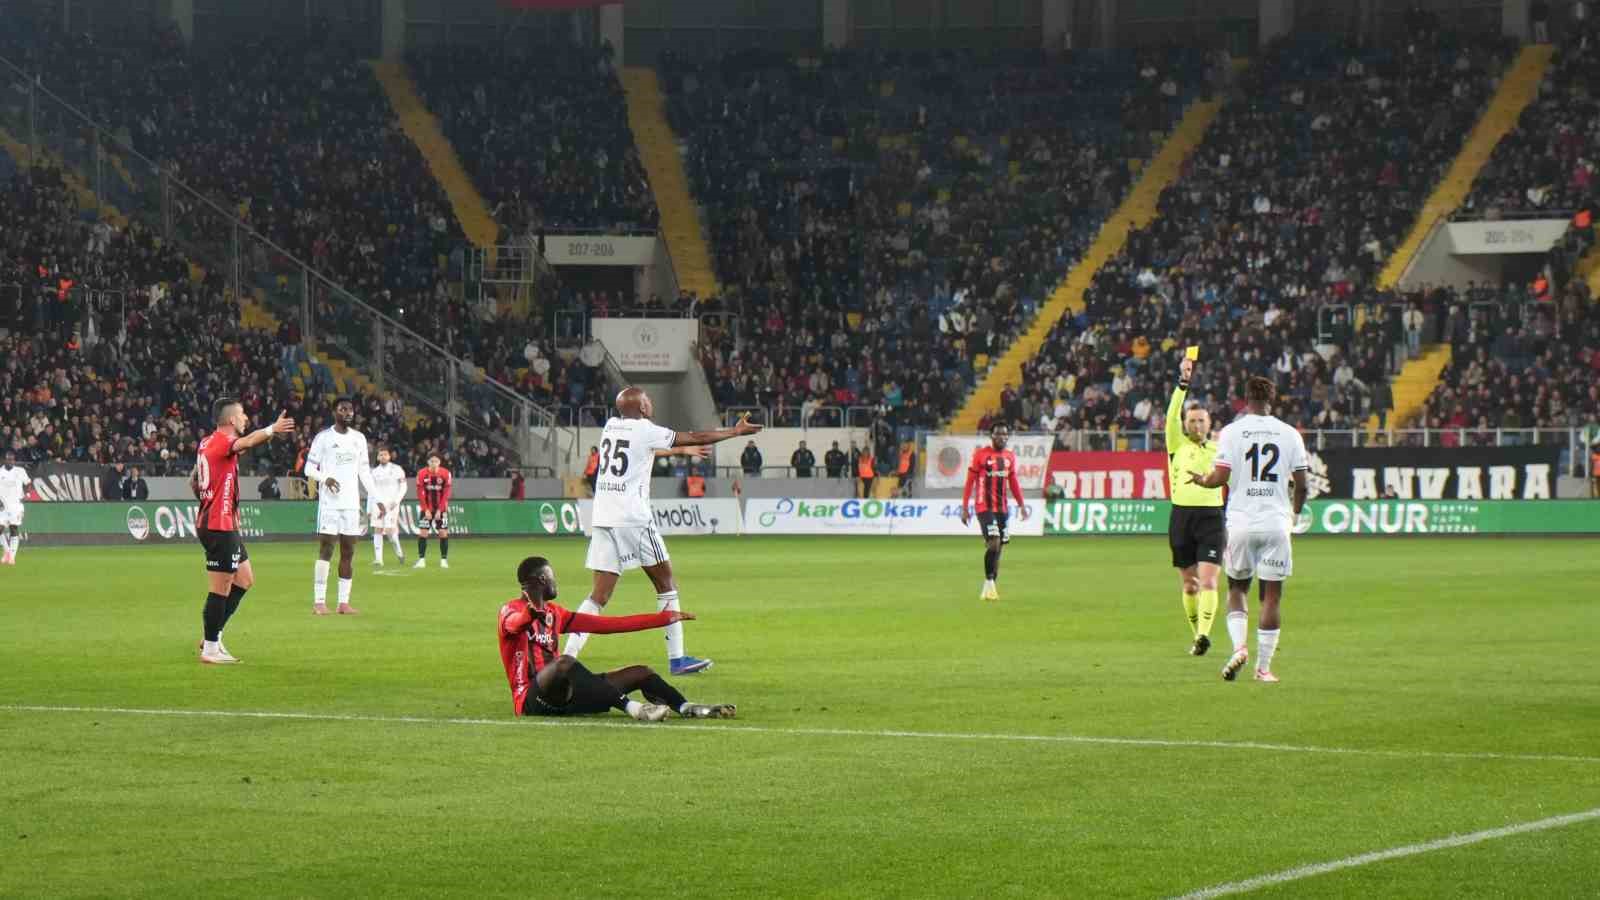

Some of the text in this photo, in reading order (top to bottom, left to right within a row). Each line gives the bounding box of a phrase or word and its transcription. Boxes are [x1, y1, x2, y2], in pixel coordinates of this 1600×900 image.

[600, 438, 630, 478] 35
[1245, 443, 1280, 482] 12
[797, 499, 928, 519] karGOkar
[1043, 503, 1108, 532] NUR
[1322, 503, 1430, 533] ONUR
